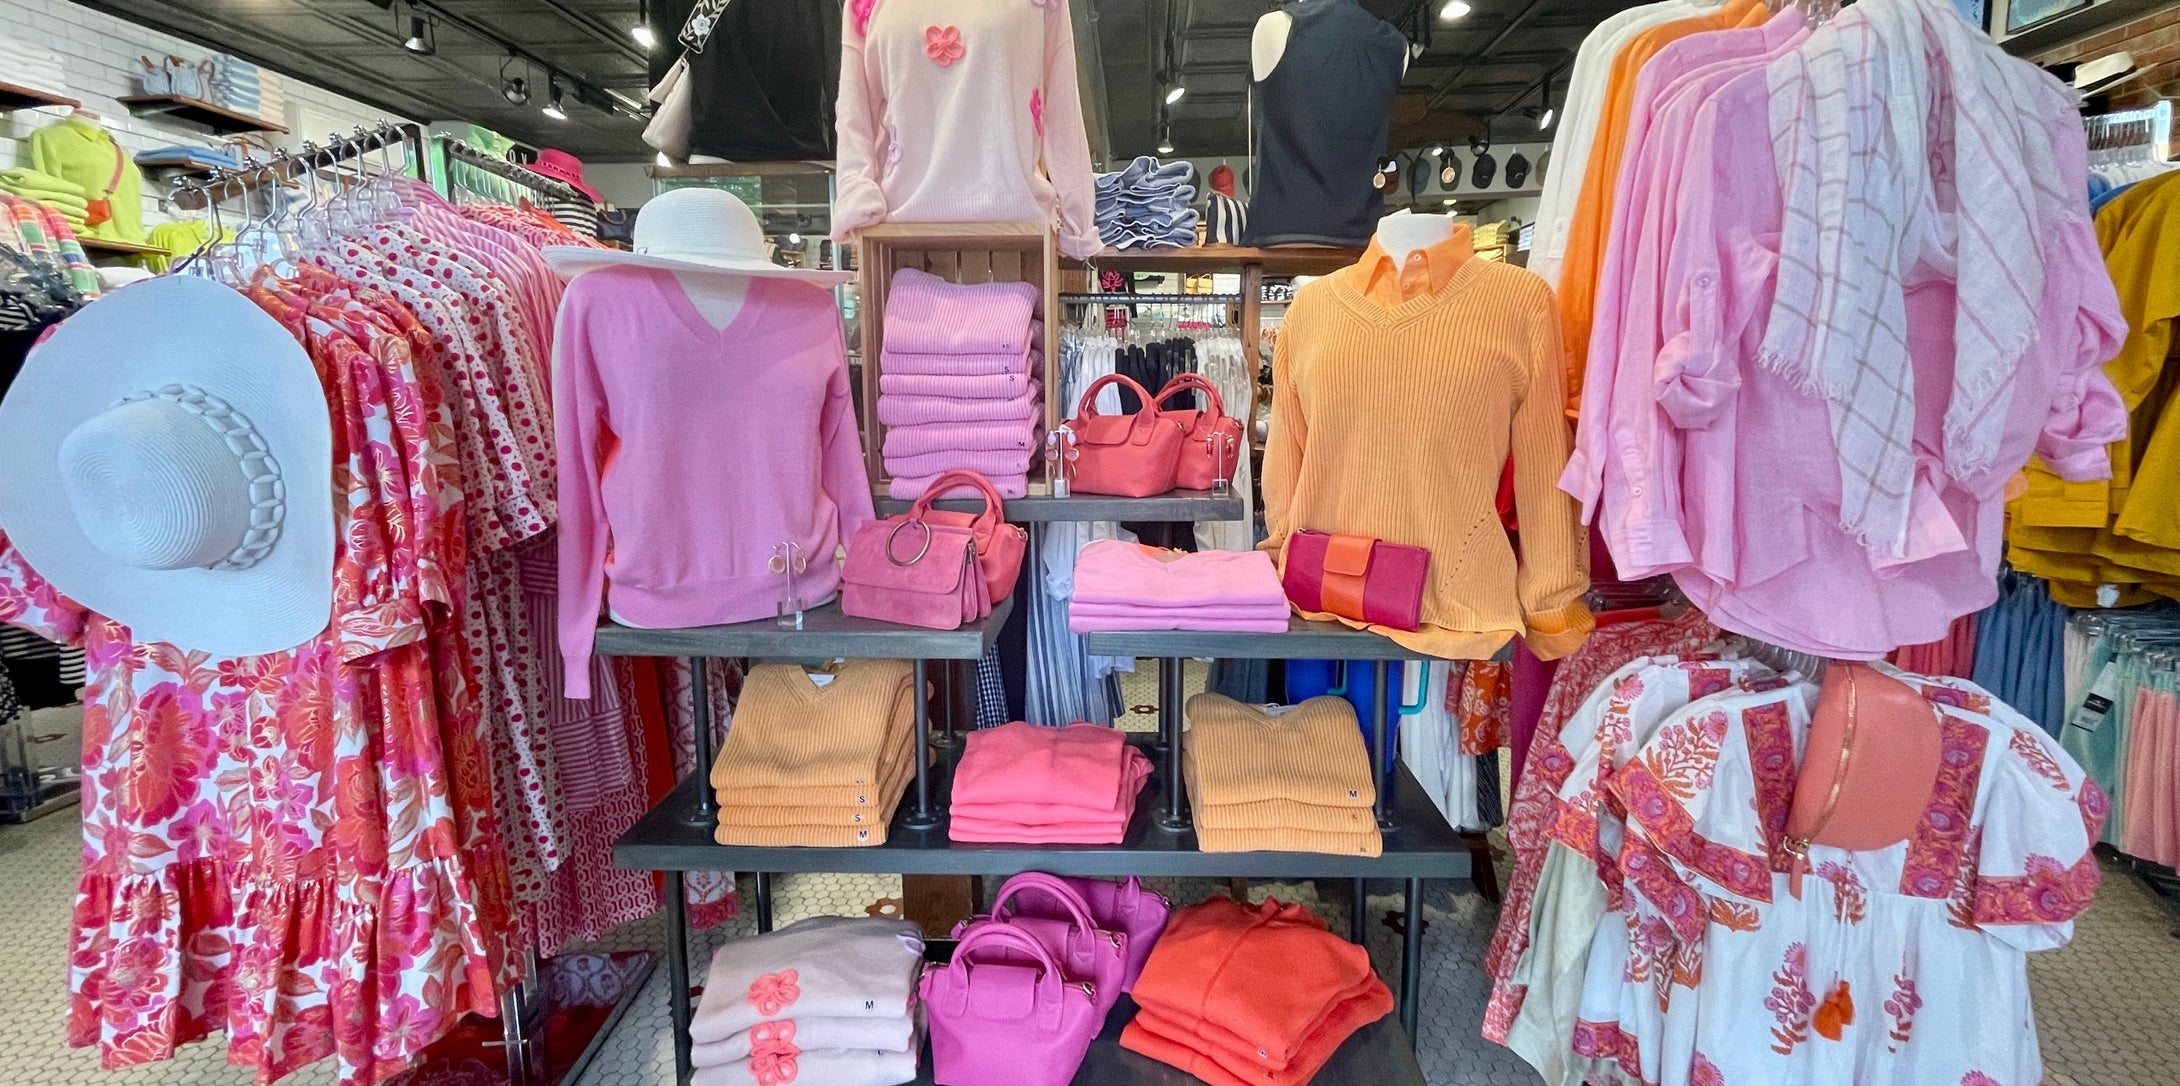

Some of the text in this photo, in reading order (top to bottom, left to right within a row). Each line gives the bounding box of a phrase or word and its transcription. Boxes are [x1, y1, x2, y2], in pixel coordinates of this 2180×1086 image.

[1350, 790, 1358, 798] M
[859, 795, 866, 804] S
[854, 813, 861, 822] S
[859, 830, 867, 839] M
[865, 1000, 874, 1010] M
